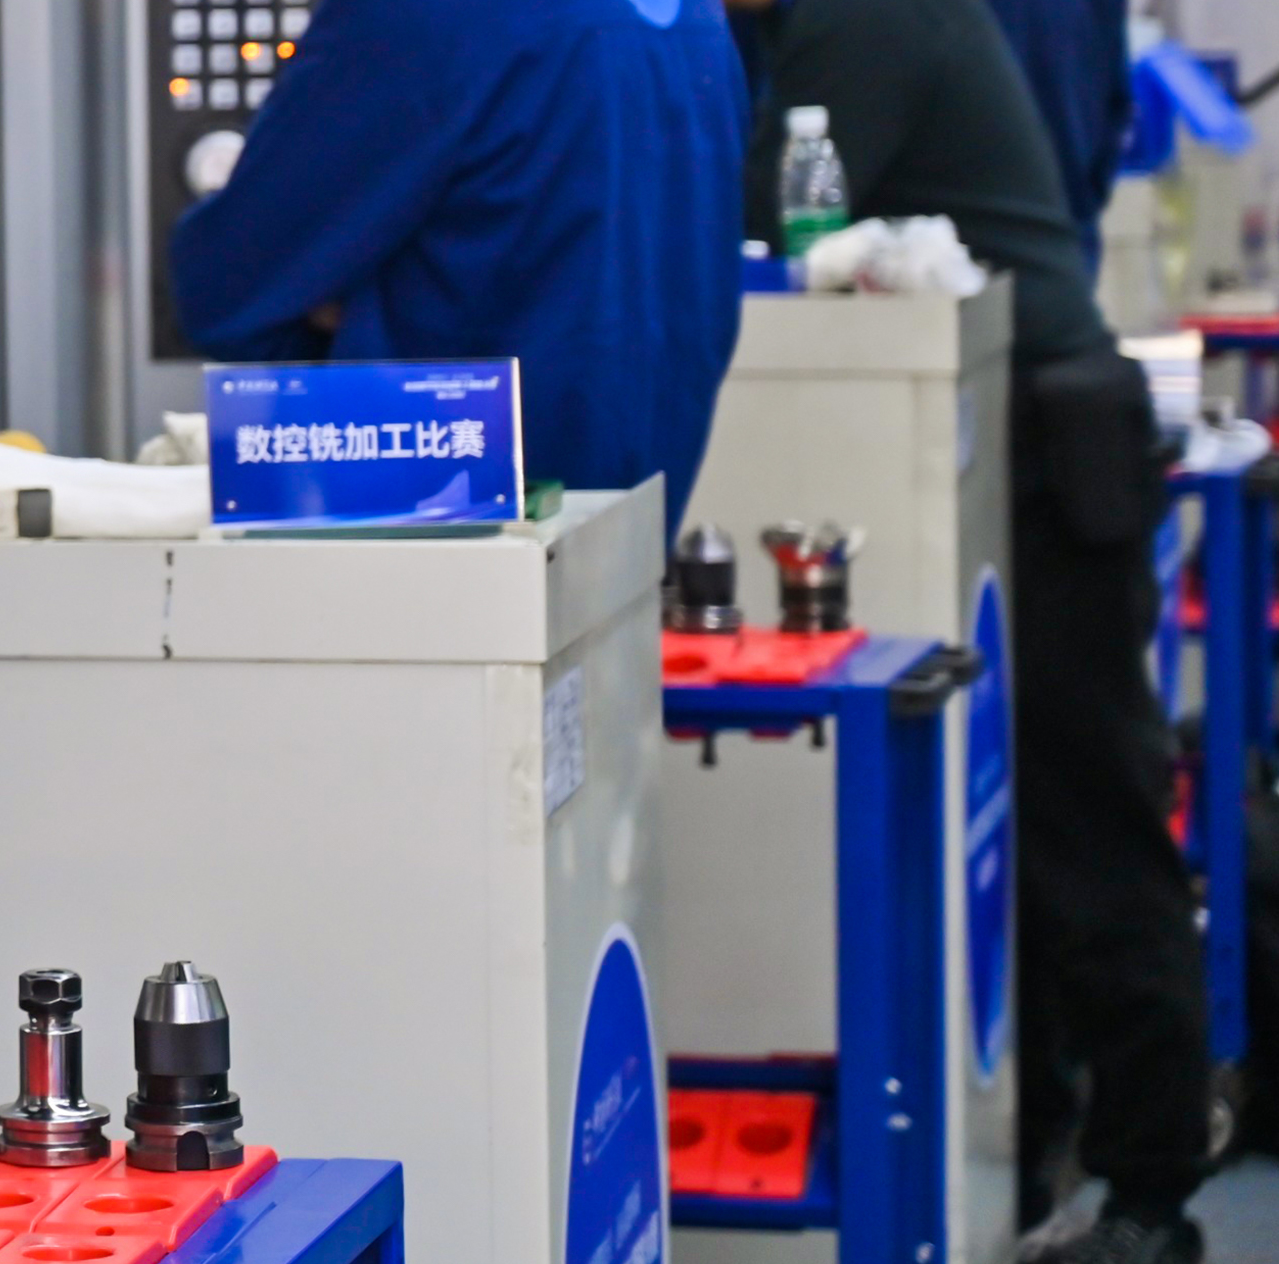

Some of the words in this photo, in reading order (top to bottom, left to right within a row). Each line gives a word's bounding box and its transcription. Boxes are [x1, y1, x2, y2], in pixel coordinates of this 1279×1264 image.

[236, 418, 487, 464] 数控铣加工比赛
